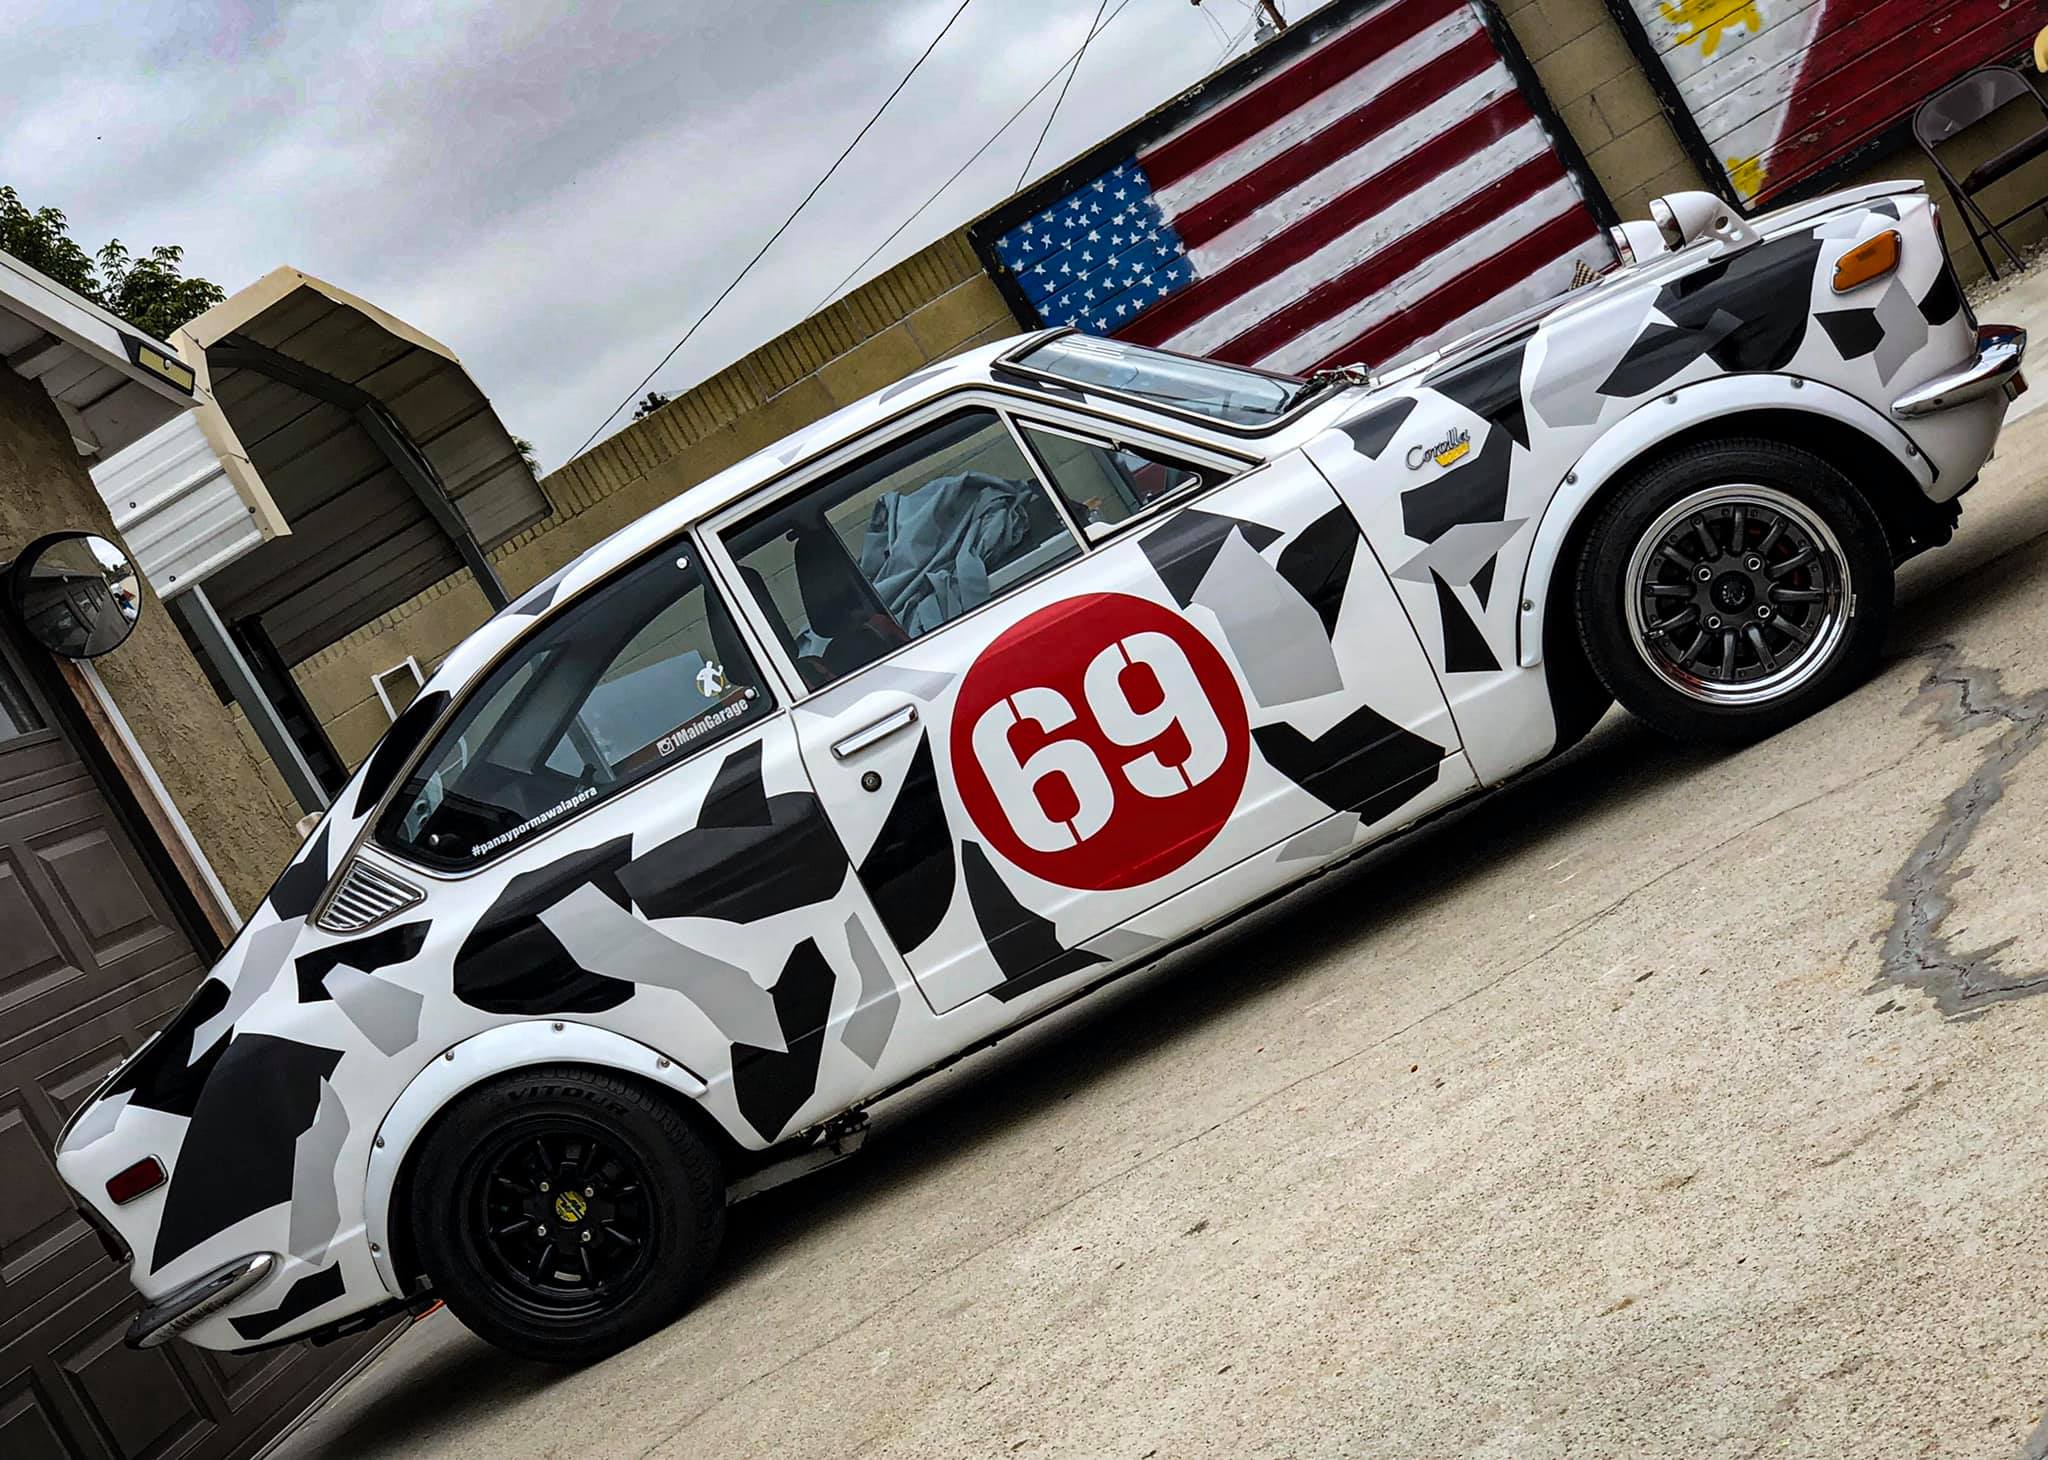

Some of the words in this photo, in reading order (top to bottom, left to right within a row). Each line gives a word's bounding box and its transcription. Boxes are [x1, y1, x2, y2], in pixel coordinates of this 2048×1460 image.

[1405, 426, 1471, 471] Corolla
[672, 698, 749, 748] 1MainGarage
[971, 631, 1228, 852] 69
[472, 786, 599, 857] #panaypormawalapera
[508, 1085, 630, 1117] VITOUR
